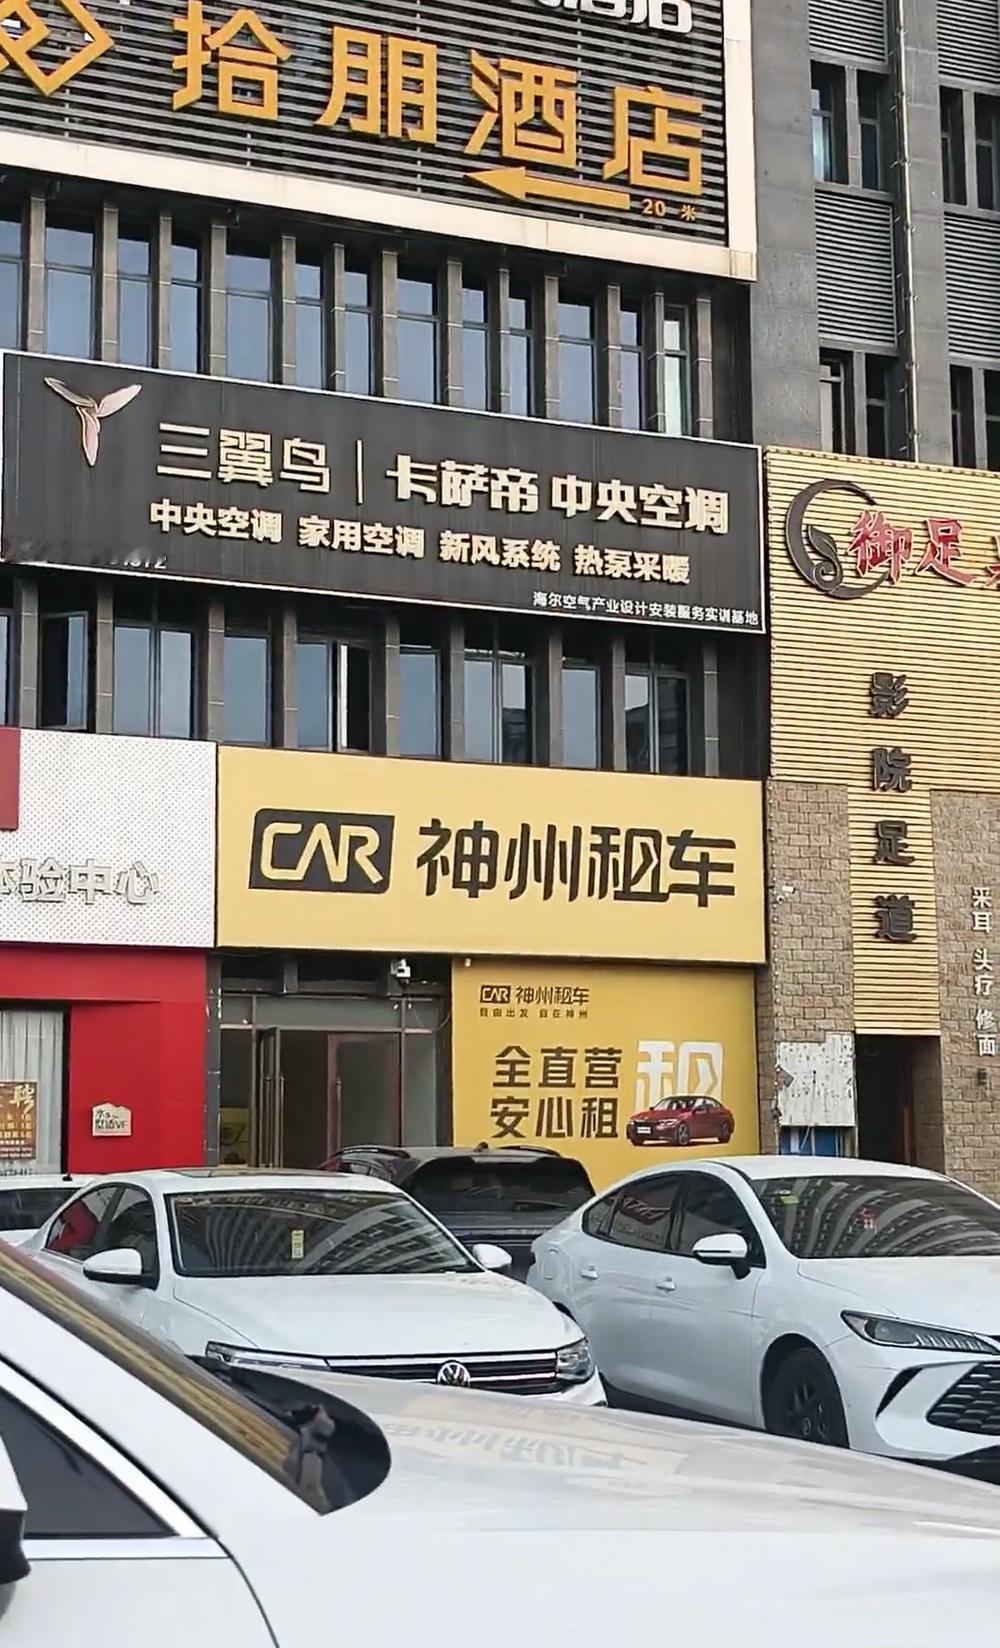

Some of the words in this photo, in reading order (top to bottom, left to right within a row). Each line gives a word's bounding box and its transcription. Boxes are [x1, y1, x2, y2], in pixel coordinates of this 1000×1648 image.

[172, 0, 703, 196] 拾朋酒店
[641, 199, 666, 217] 20
[681, 204, 697, 221] 米
[157, 422, 330, 493] 三翼鸟
[386, 455, 539, 513] 卡萨帝
[551, 475, 729, 534] 中央空调
[150, 498, 283, 543] 中央空调
[298, 515, 425, 558] 家用空调
[439, 530, 562, 571] 新风系统
[574, 544, 691, 585] 热泵采暖
[847, 510, 1000, 586] 御足
[532, 591, 759, 626] 海尔空气产业设计安装服务实训基地
[869, 672, 917, 943] 影院足道
[261, 822, 384, 882] CAR
[417, 818, 736, 907] 神州租车
[972, 886, 992, 933] 采耳
[482, 986, 510, 1003] CAR
[515, 985, 589, 1006] 神州租车
[973, 948, 994, 996] 头疗
[975, 1007, 997, 1057] 修面
[492, 1045, 622, 1089] 全直营
[490, 1096, 619, 1139] 安心租
